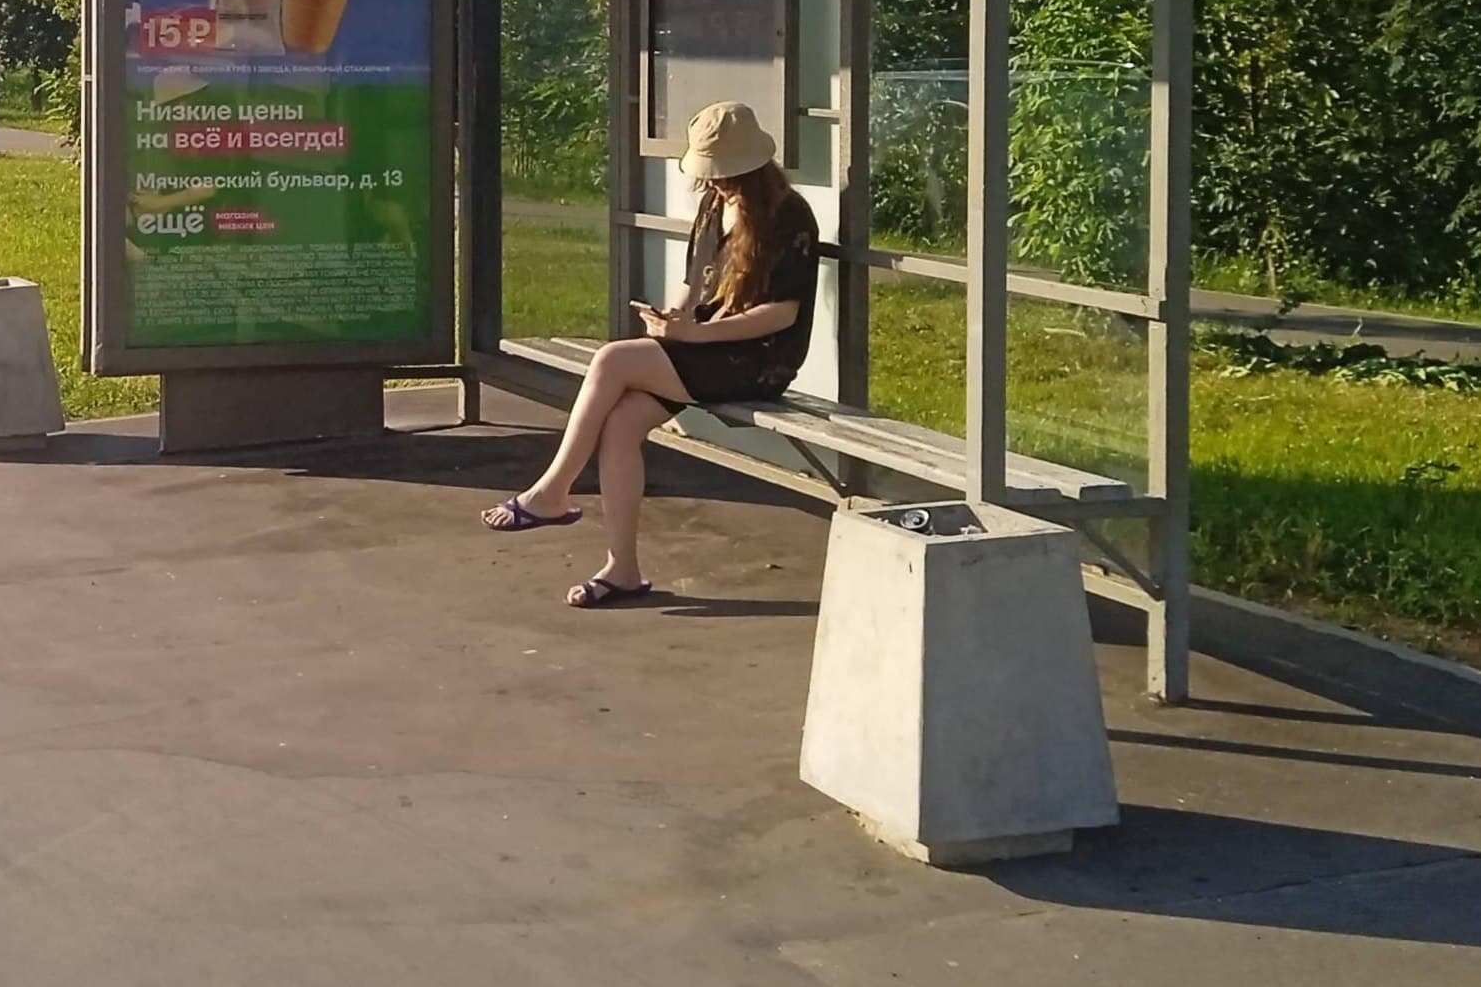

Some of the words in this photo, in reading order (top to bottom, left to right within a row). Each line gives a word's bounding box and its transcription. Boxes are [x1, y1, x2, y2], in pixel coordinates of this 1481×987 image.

[136, 101, 232, 122] Низкие
[238, 101, 304, 124] цены
[136, 131, 168, 149] на
[174, 127, 221, 149] всё
[227, 131, 243, 148] и
[248, 127, 345, 151] всегда!
[136, 170, 262, 190] Мячковский
[267, 170, 355, 192] бульвар,
[359, 173, 378, 190] д.
[382, 169, 404, 187] 13
[137, 205, 206, 238] ещё
